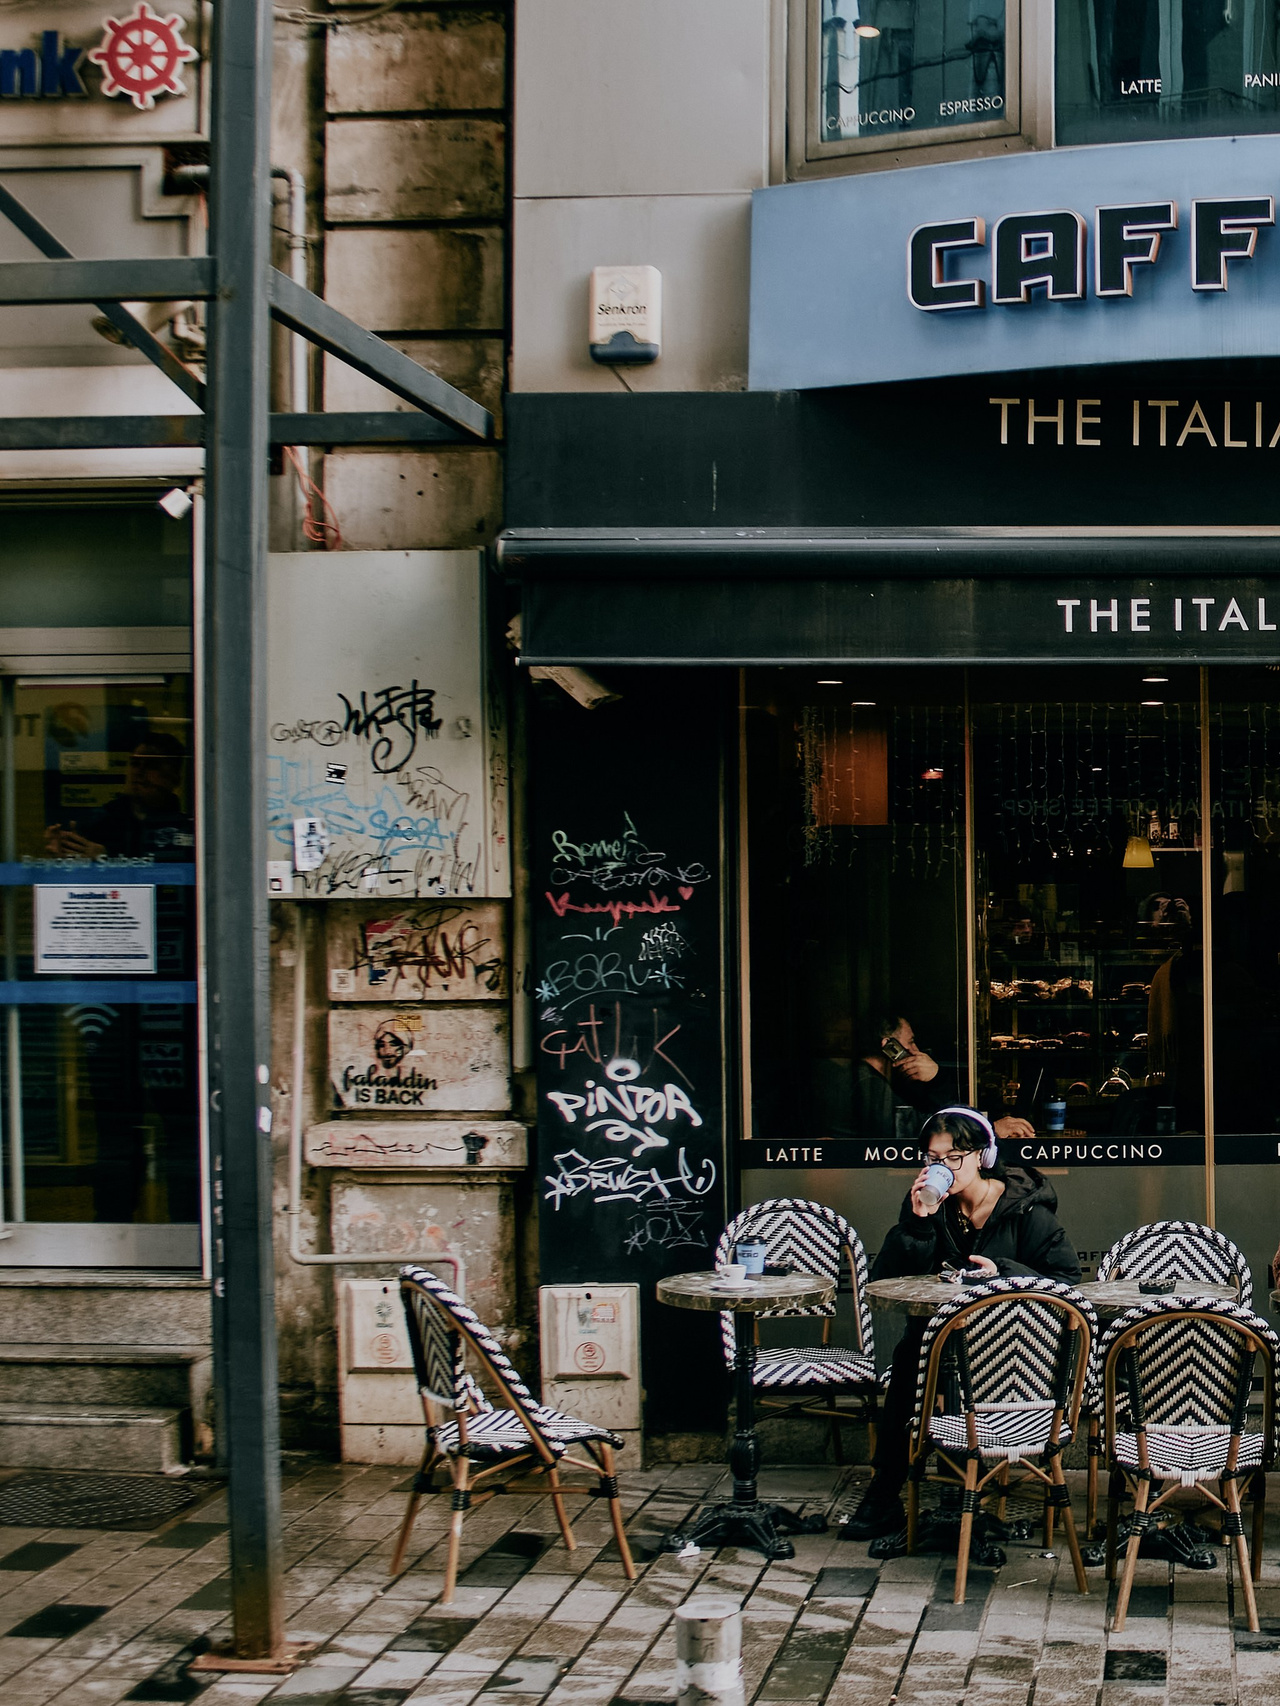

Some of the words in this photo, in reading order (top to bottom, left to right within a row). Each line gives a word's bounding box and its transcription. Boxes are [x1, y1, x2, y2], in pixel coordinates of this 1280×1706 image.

[1121, 78, 1162, 95] LATTE
[939, 95, 1004, 116] ESPRESSO
[826, 106, 916, 131] CAPPUCCINO
[597, 303, 648, 316] Senkron
[989, 398, 1102, 446] THE
[1057, 598, 1151, 633] THE
[355, 1089, 371, 1103] IS
[375, 1090, 424, 1106] BACK
[766, 1147, 823, 1162] LATTE
[1020, 1144, 1163, 1161] CAPPUCCINO
